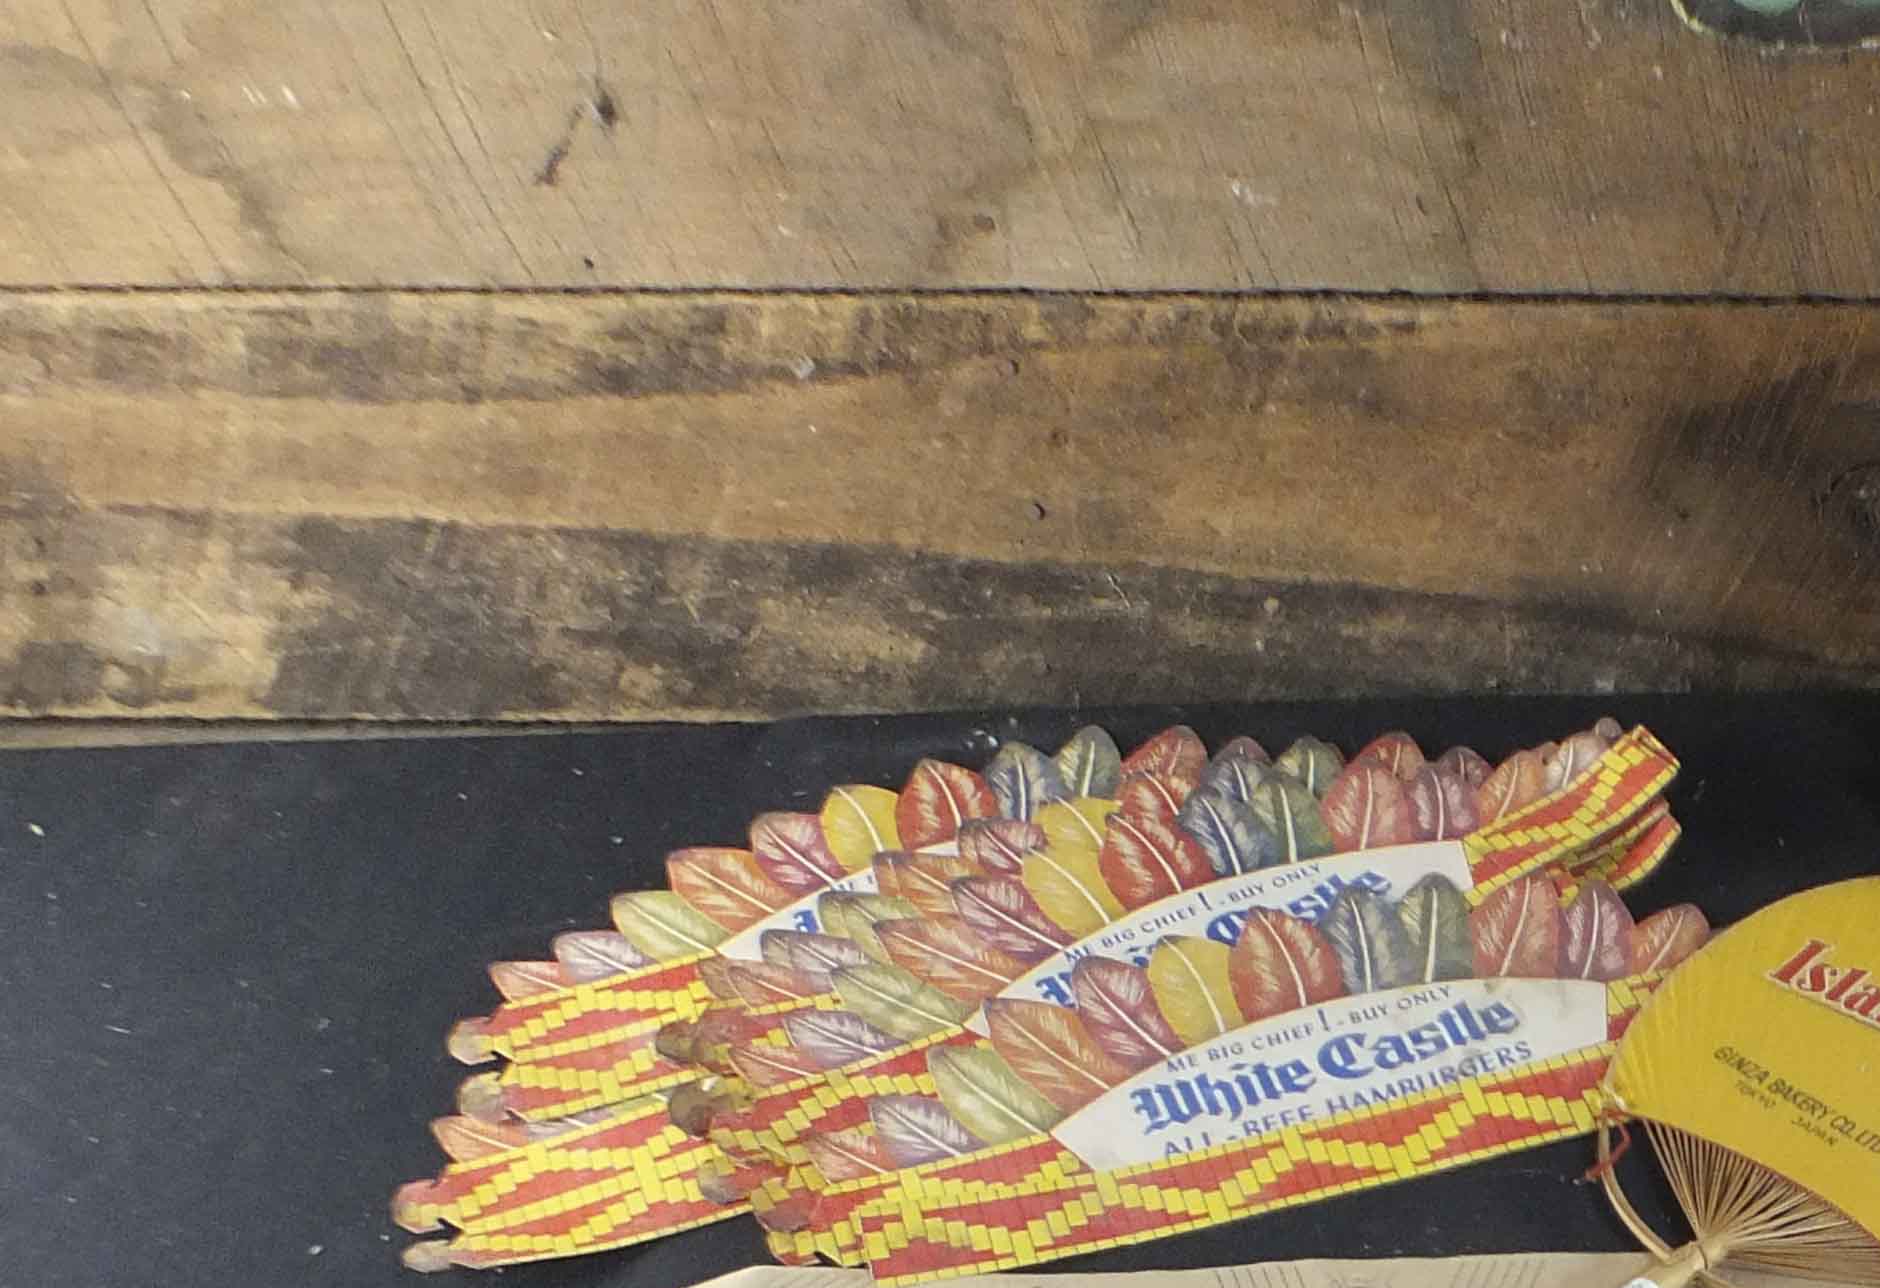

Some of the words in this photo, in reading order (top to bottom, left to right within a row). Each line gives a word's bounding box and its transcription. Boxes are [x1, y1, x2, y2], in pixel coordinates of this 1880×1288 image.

[1100, 928, 1137, 951] BIG
[1229, 882, 1266, 905] BUY
[1271, 863, 1322, 888] ONLY
[1130, 1061, 1318, 1136] White
[1317, 1000, 1521, 1080] Castle
[1166, 1053, 1198, 1074] ME
[1207, 1040, 1245, 1062] BIG
[1350, 1005, 1389, 1025] BUY
[1398, 985, 1453, 1010] ONLY
[1714, 1045, 1771, 1083] GINZA
